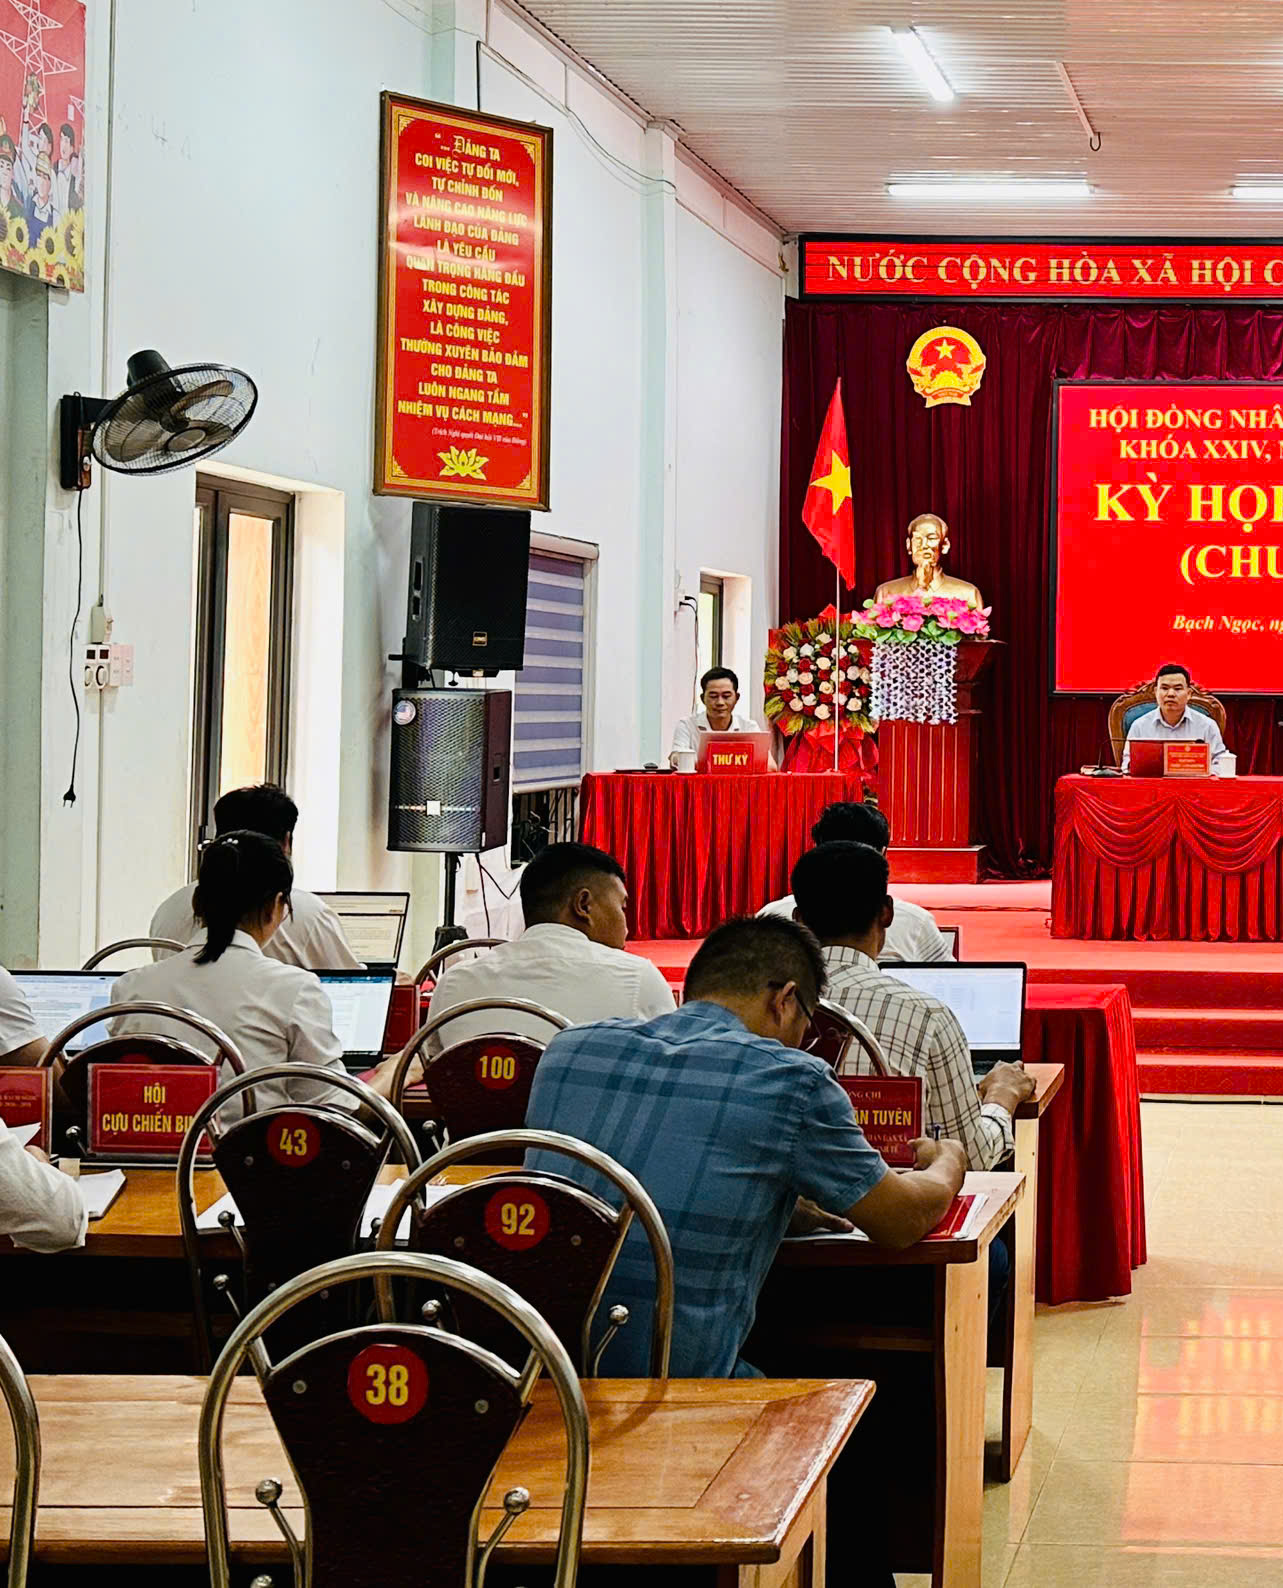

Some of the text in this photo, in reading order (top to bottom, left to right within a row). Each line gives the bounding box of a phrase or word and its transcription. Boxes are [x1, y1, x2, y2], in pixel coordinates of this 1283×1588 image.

[452, 135, 500, 161] ĐẢNG TA
[415, 153, 433, 168] COI
[435, 157, 459, 174] VIỆC
[461, 161, 475, 178] TỰ
[476, 163, 494, 180] ĐỔI
[432, 176, 503, 202] TỰ CHỈNH ĐỐN
[406, 190, 419, 207] VÀ
[454, 202, 474, 217] CAO
[444, 220, 465, 237] ĐẠO
[467, 223, 489, 240] CỦA
[491, 227, 520, 246] ĐẢNG
[437, 238, 496, 262] LÀ YÊU CẦU
[406, 255, 526, 287] QUAN TRỌNG HÀNG ĐẦU
[827, 247, 929, 282] NƯỚC
[937, 253, 1036, 290] CỘNG
[1047, 250, 1121, 285] HÒA
[1131, 252, 1179, 286] XÃ
[1191, 255, 1253, 292] HỘI
[422, 278, 510, 304] TRONG CÔNG TÁC
[423, 298, 475, 320] XÂY DỰNG
[430, 320, 500, 345] LÀ CÔNG VIỆC
[400, 337, 529, 368] THƯỜNG XUYÊN BẢO ĐẢM
[431, 362, 498, 384] CHO ĐẢNG TA
[418, 380, 510, 406] LUÔN NGANG TẦM
[398, 399, 433, 418] NHIỆM
[435, 404, 450, 421] VỤ
[452, 405, 480, 422] CÁCH
[1089, 405, 1139, 433] HỘI
[1146, 403, 1223, 429] ĐỒNG
[1119, 433, 1198, 459] KHÓA
[1203, 439, 1272, 463] XXIV,
[1094, 471, 1173, 522] KỲ
[1173, 614, 1214, 632] Bạch
[1221, 615, 1265, 634] Ngọc,
[712, 752, 748, 766] THƯ KÝ
[479, 1056, 515, 1080] 100
[144, 1082, 166, 1108] HỘI
[102, 1108, 196, 1136] CỰU CHIẾN BI
[853, 1106, 912, 1126] ĂN TUYÊN
[279, 1128, 307, 1156] 43
[501, 1203, 536, 1236] 92
[366, 1363, 410, 1406] 38
